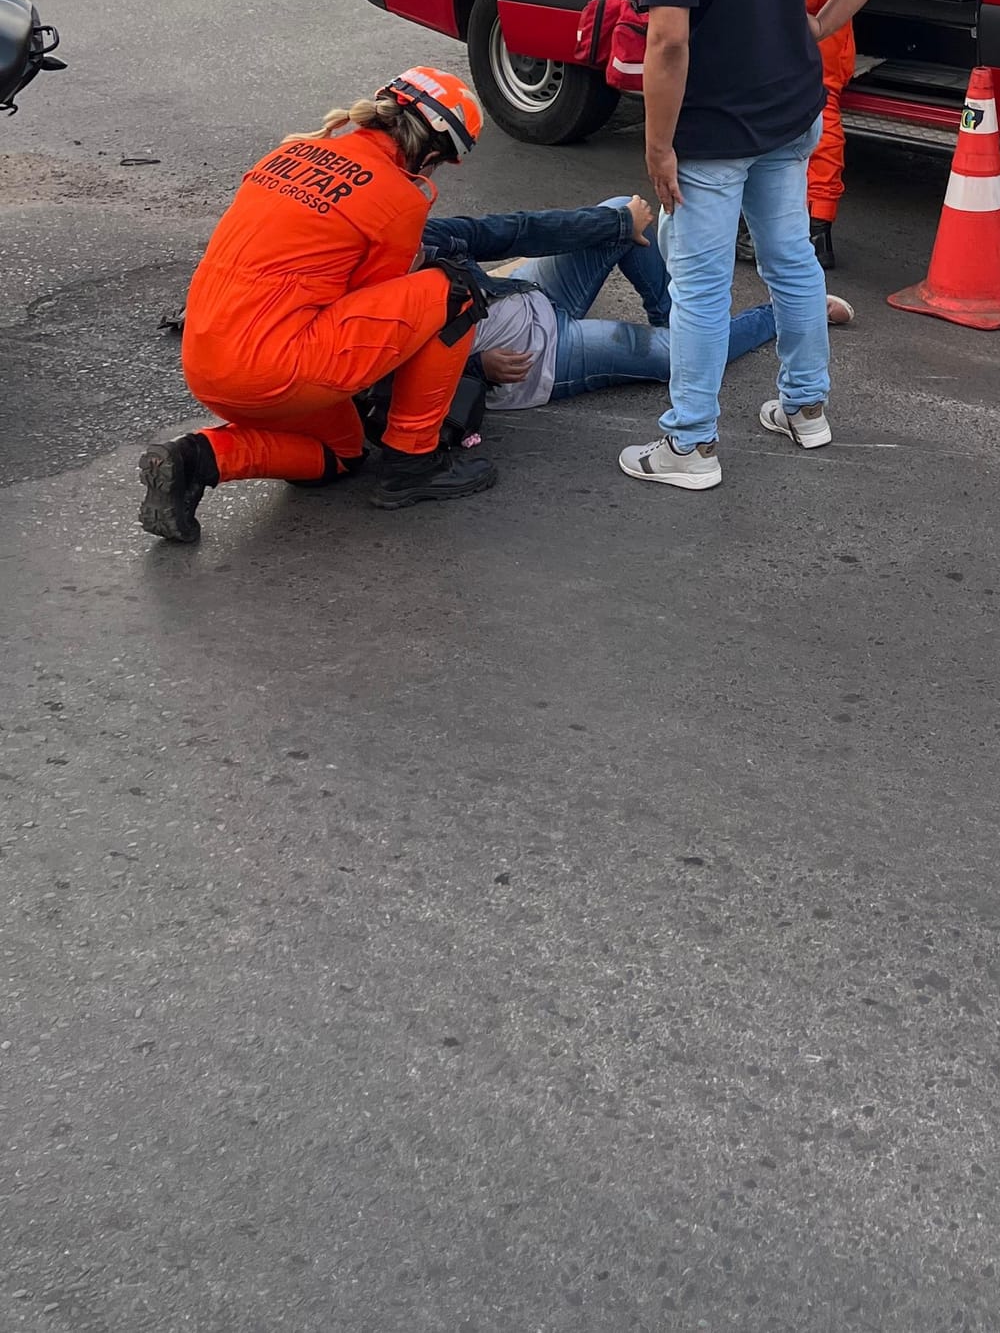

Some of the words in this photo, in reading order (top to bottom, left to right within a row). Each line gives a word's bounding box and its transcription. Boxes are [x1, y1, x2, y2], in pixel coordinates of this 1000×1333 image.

[261, 154, 353, 204] MILITAR
[284, 142, 373, 186] BOMBEIRO
[251, 171, 280, 189] MATO
[279, 184, 330, 214] GROSSO
